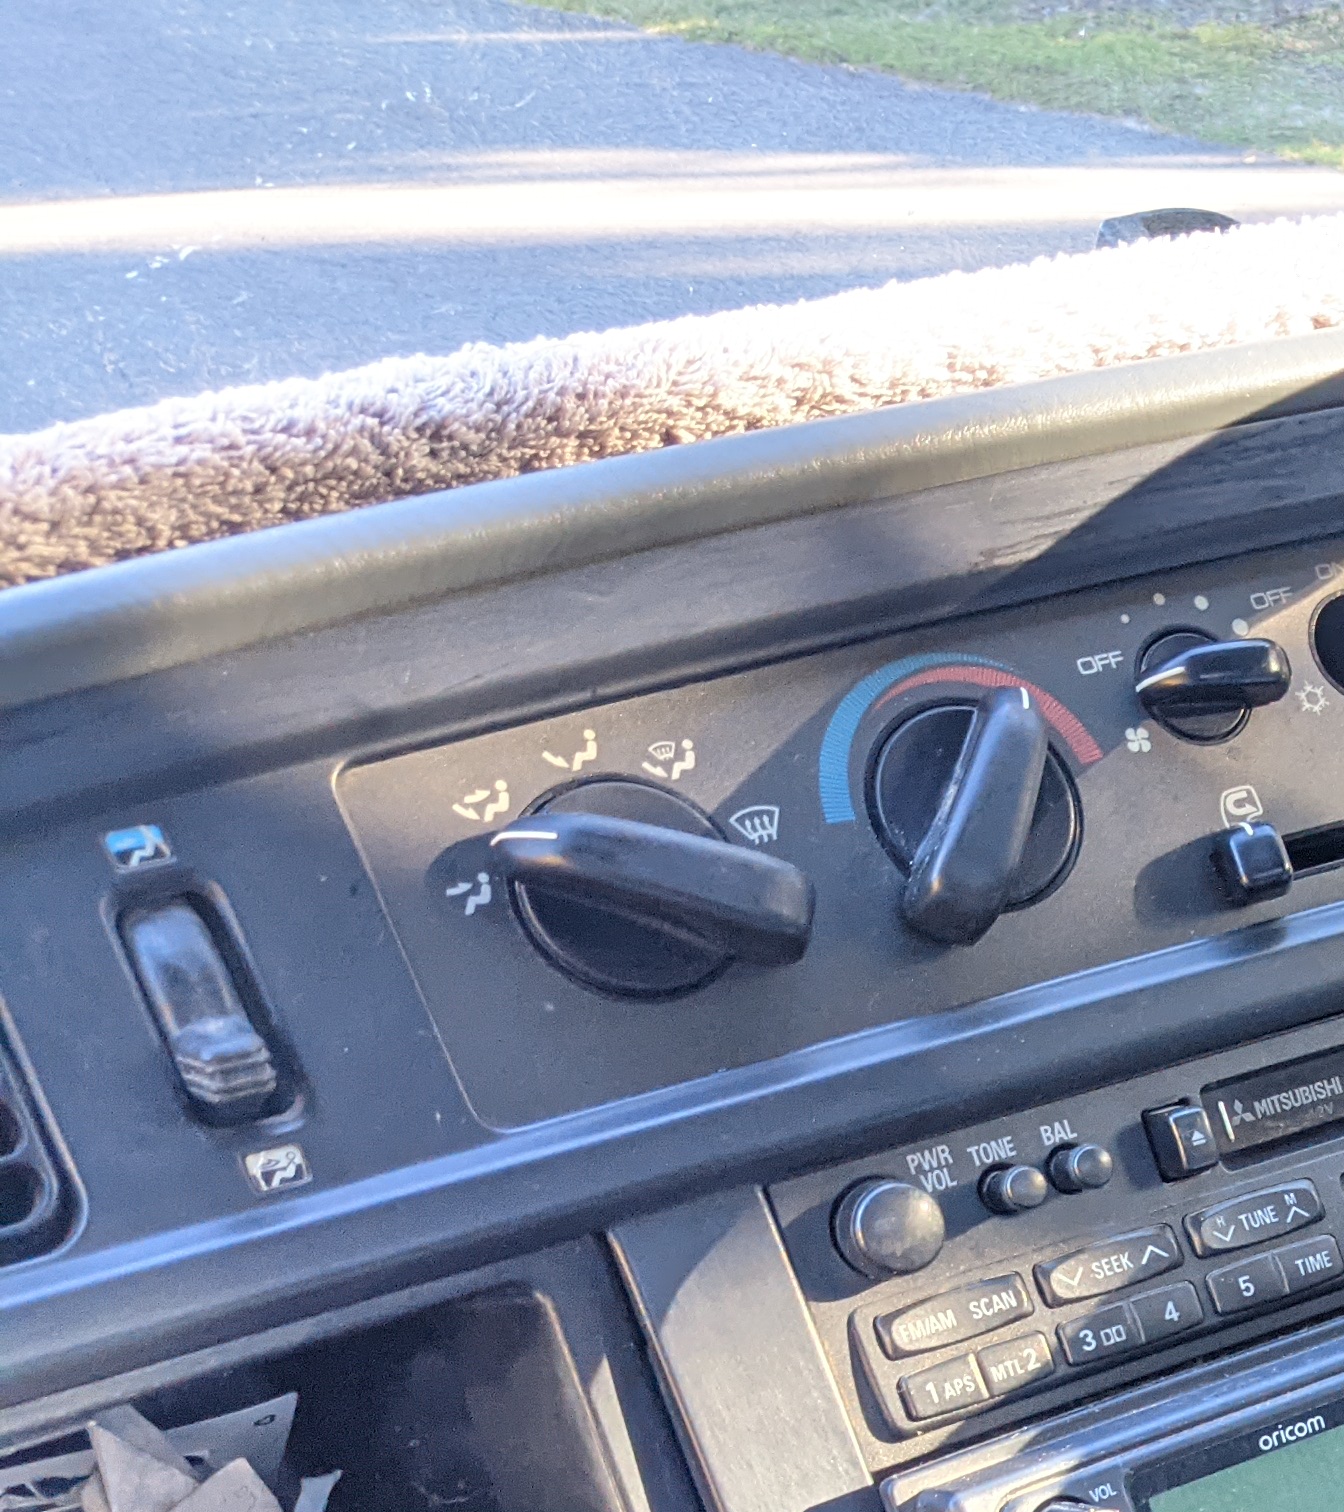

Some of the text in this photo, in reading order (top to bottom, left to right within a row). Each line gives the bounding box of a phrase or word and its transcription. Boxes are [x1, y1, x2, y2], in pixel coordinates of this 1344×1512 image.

[1250, 586, 1294, 611] OFF
[1077, 651, 1124, 675] OFF
[1253, 1076, 1344, 1120] MITSUBISHI
[1039, 1119, 1078, 1146] BAL
[905, 1144, 954, 1176] PWR
[967, 1136, 1016, 1168] TONE
[919, 1168, 958, 1194] VOL
[1284, 1192, 1298, 1206] M
[1237, 1205, 1280, 1232] TUNE
[1090, 1255, 1135, 1281] SEEK
[1294, 1250, 1334, 1276] TIME
[1238, 1276, 1256, 1298] 5
[898, 1290, 1018, 1344] FM/AM SCAN
[1163, 1301, 1181, 1323] 4
[1079, 1328, 1098, 1352] 3
[990, 1347, 1042, 1383] MTL 2
[924, 1376, 977, 1404] 1 APS
[1258, 1414, 1326, 1451] oricom
[1088, 1481, 1118, 1504] VOL
